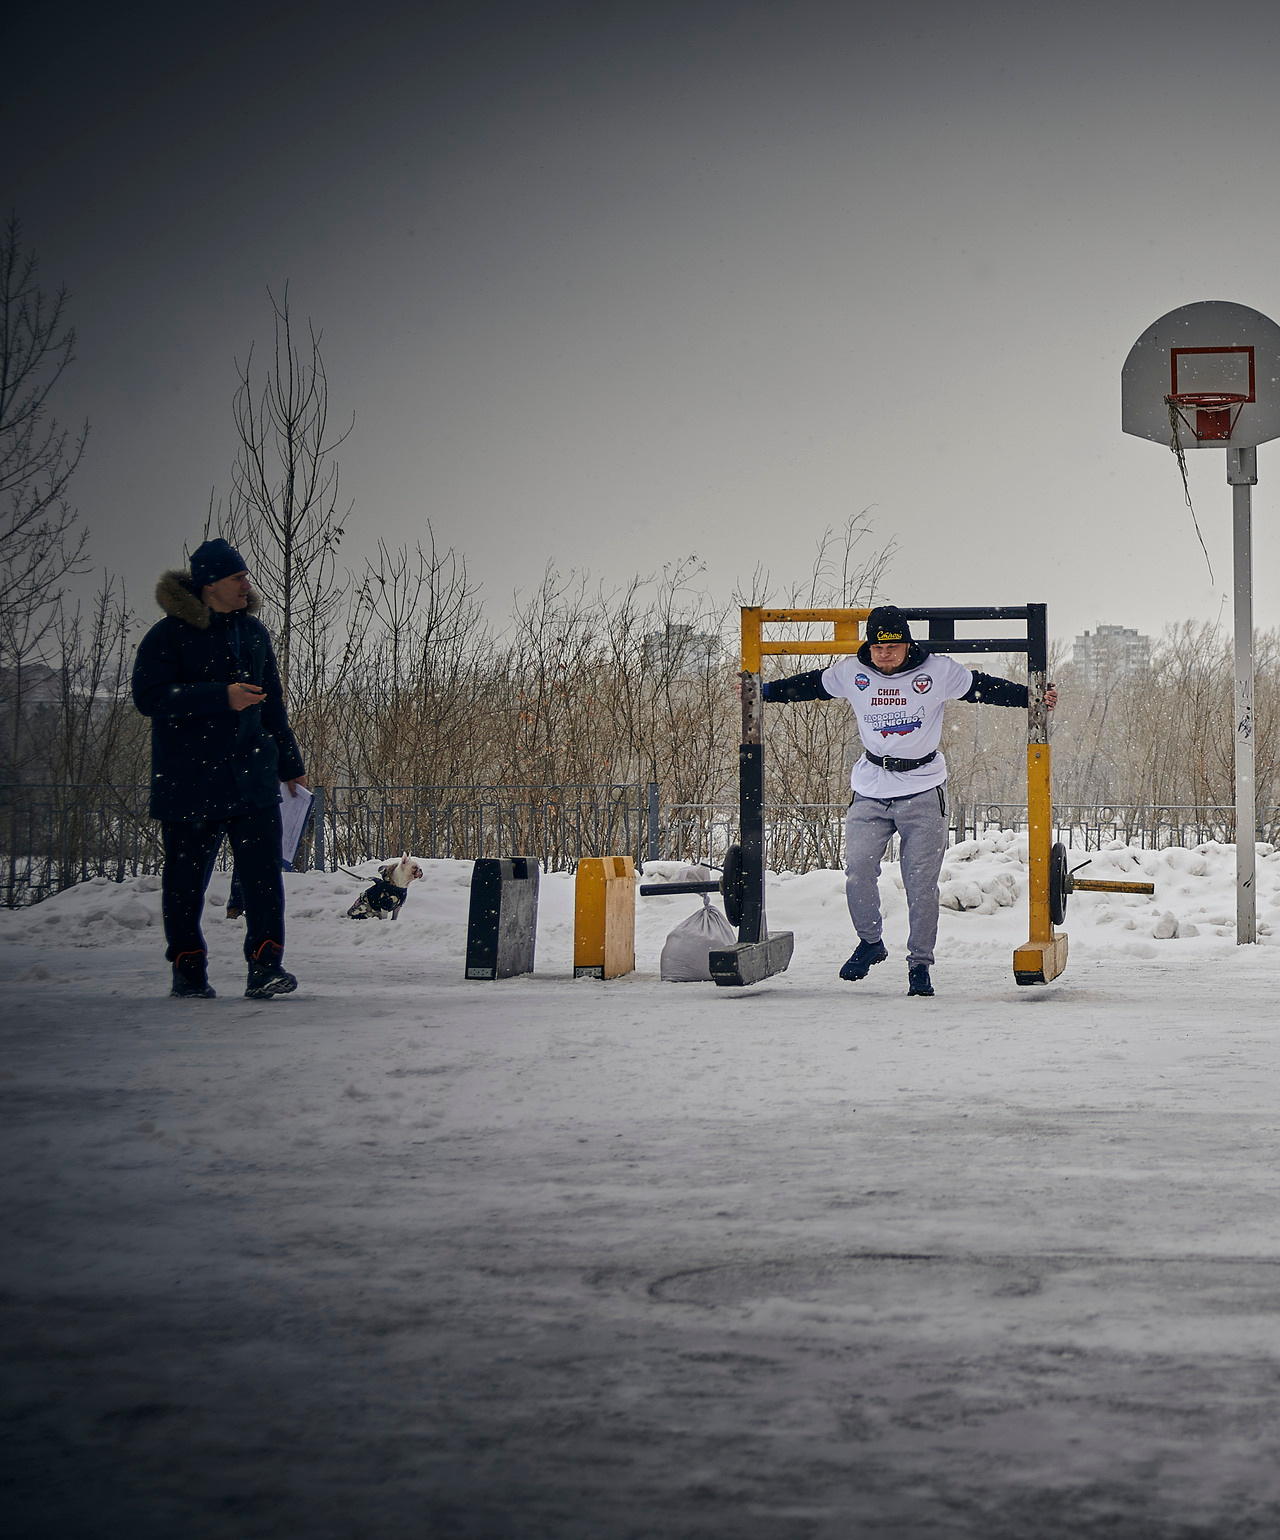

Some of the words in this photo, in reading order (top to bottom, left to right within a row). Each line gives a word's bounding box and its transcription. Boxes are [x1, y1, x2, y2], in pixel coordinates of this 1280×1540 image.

[877, 688, 900, 696] СИЛА
[871, 697, 907, 706] ДВОРОВ
[872, 716, 919, 728] ОТЕЧЕСТВО
